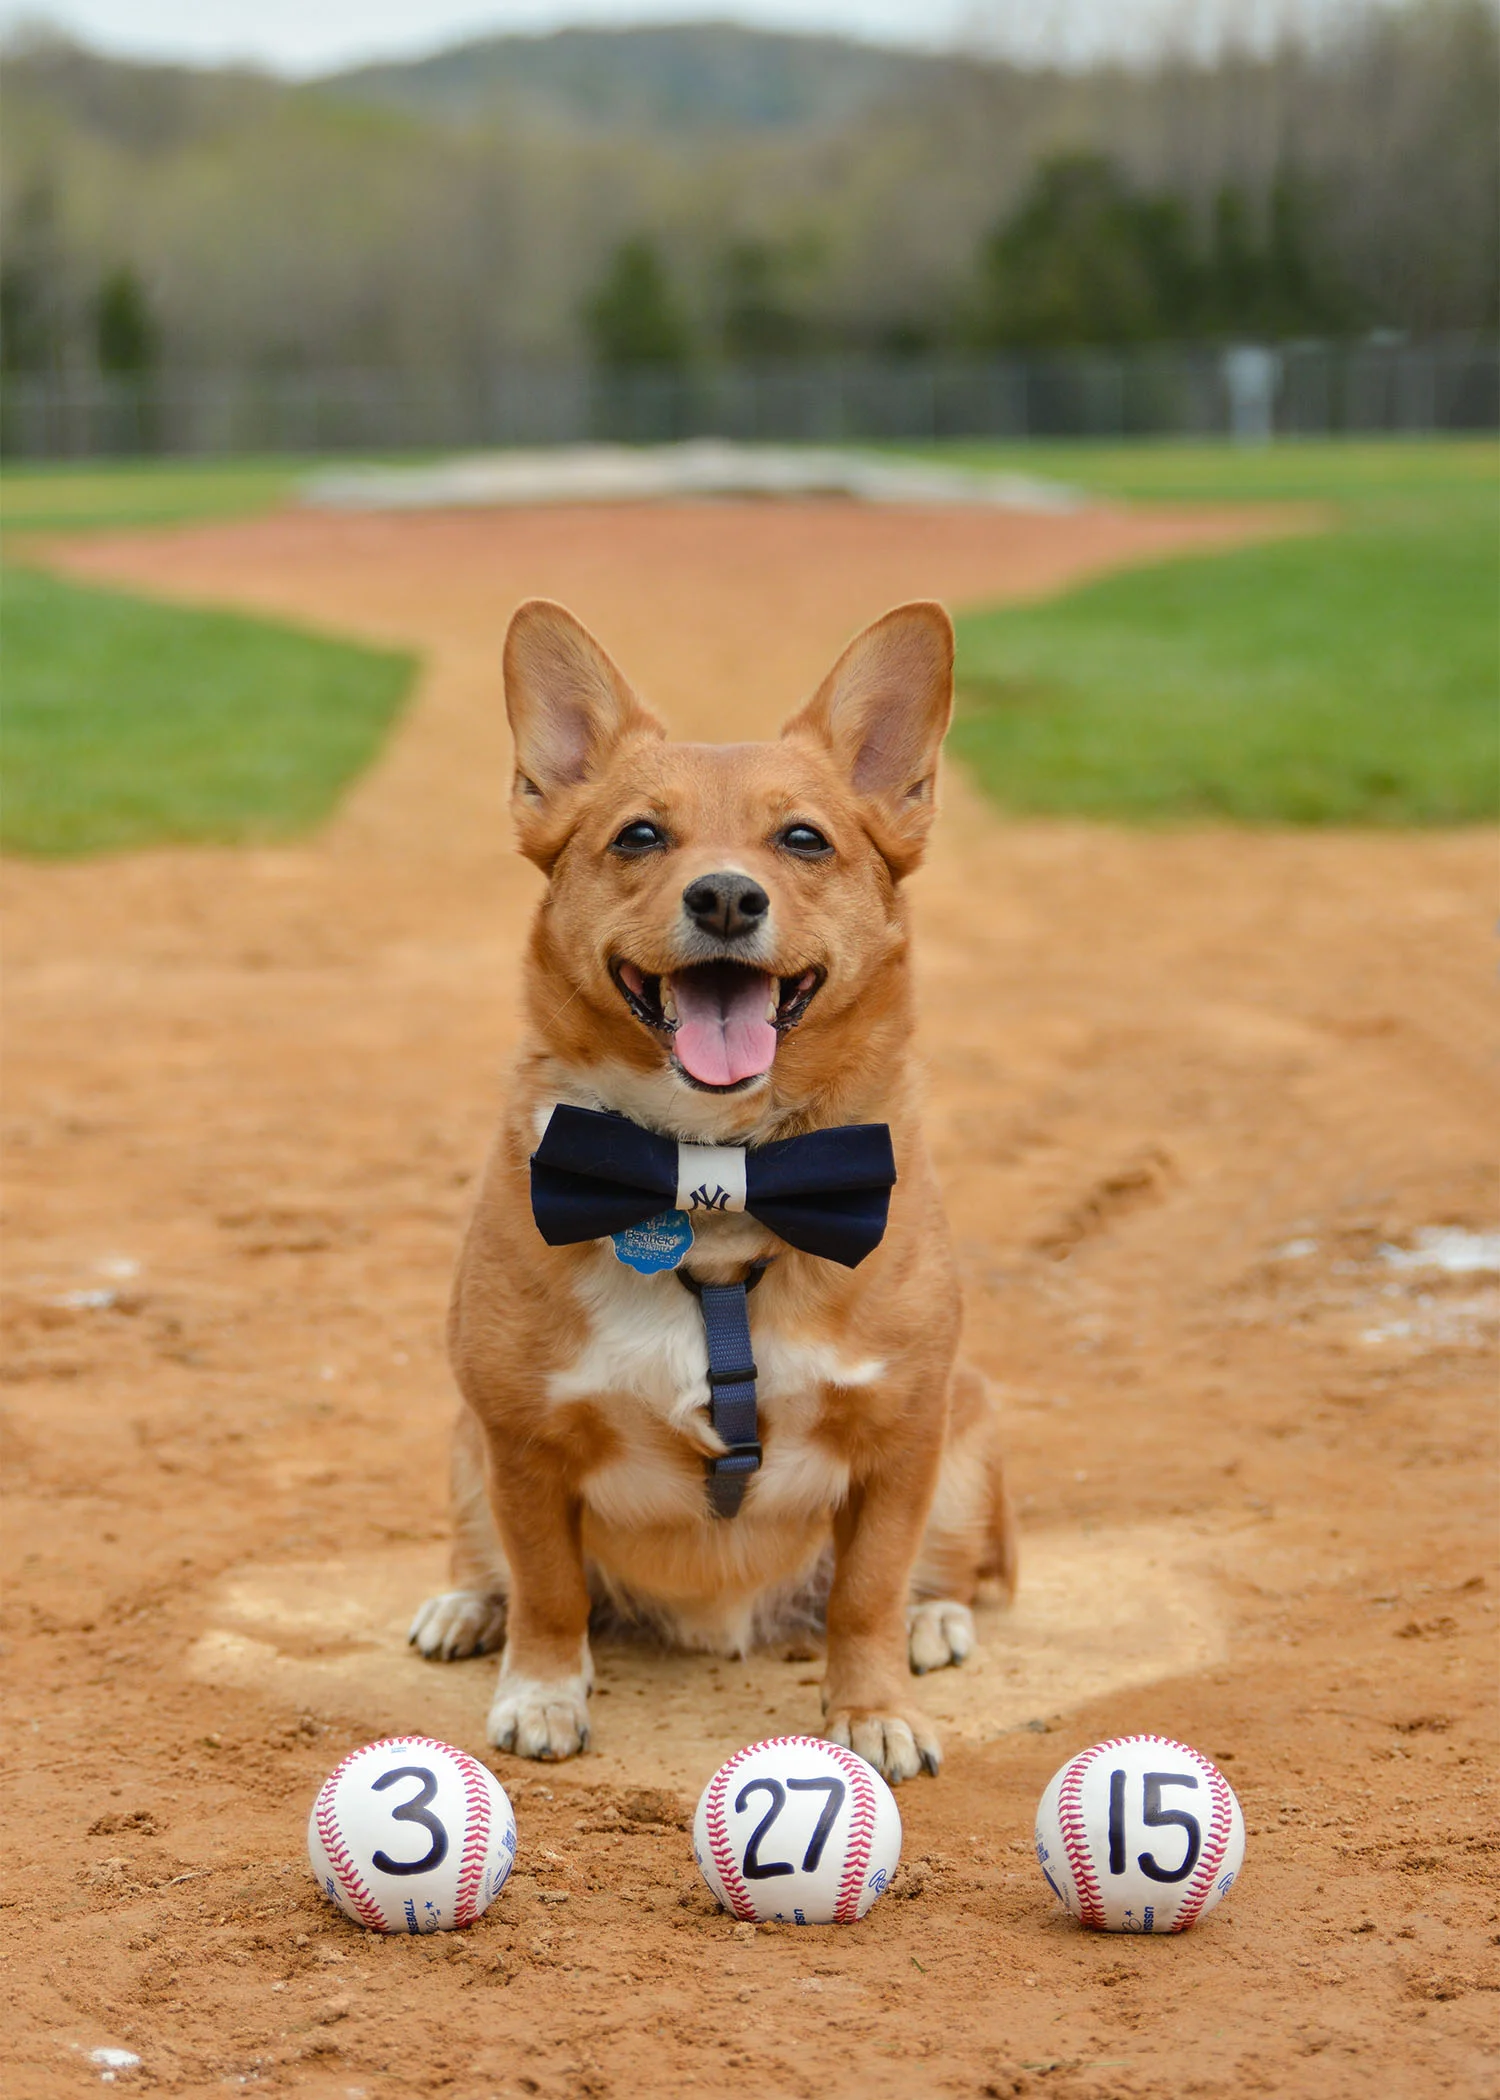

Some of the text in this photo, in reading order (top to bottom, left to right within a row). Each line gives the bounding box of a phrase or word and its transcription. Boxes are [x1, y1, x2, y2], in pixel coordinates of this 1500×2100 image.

[625, 1228, 678, 1247] Banfield
[371, 1766, 449, 1876] 3
[735, 1776, 846, 1880] 27
[1108, 1769, 1201, 1883] 15
